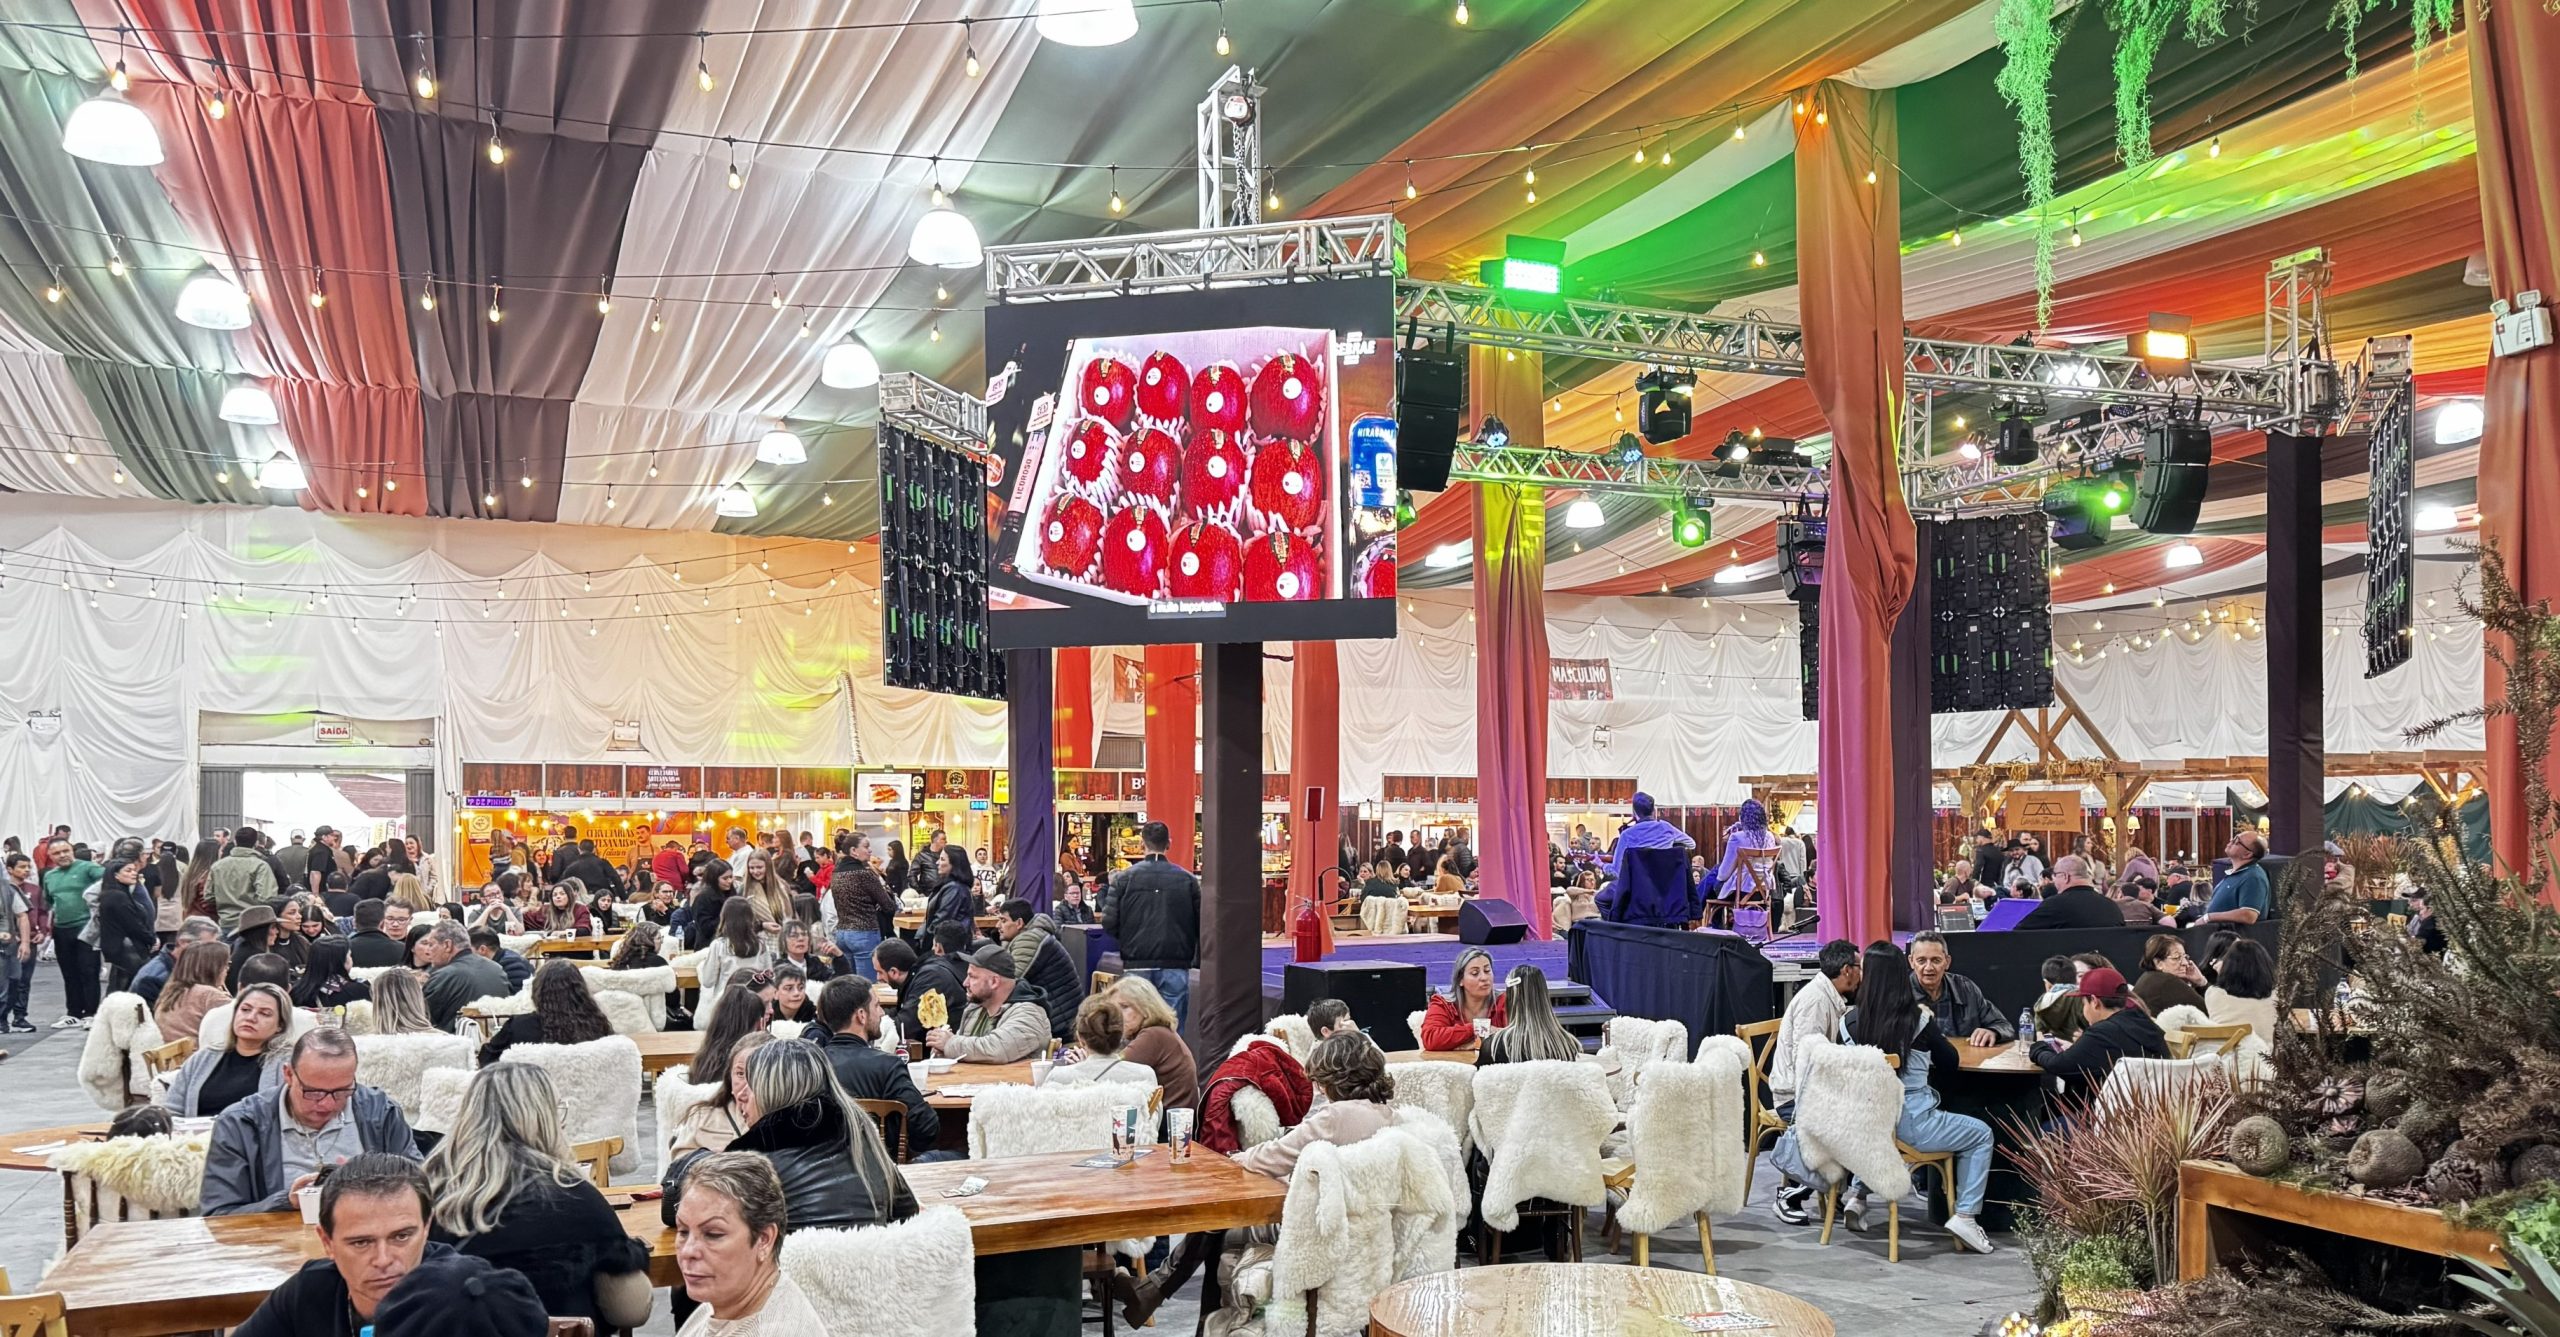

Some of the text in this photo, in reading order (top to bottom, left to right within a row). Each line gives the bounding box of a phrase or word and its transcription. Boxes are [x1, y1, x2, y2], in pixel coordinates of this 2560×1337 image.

[1015, 458, 1032, 500] LICOROSO
[1552, 666, 1607, 683] MASCULINO
[320, 724, 348, 735] SAÍDA
[595, 838, 629, 848] TESANAIS
